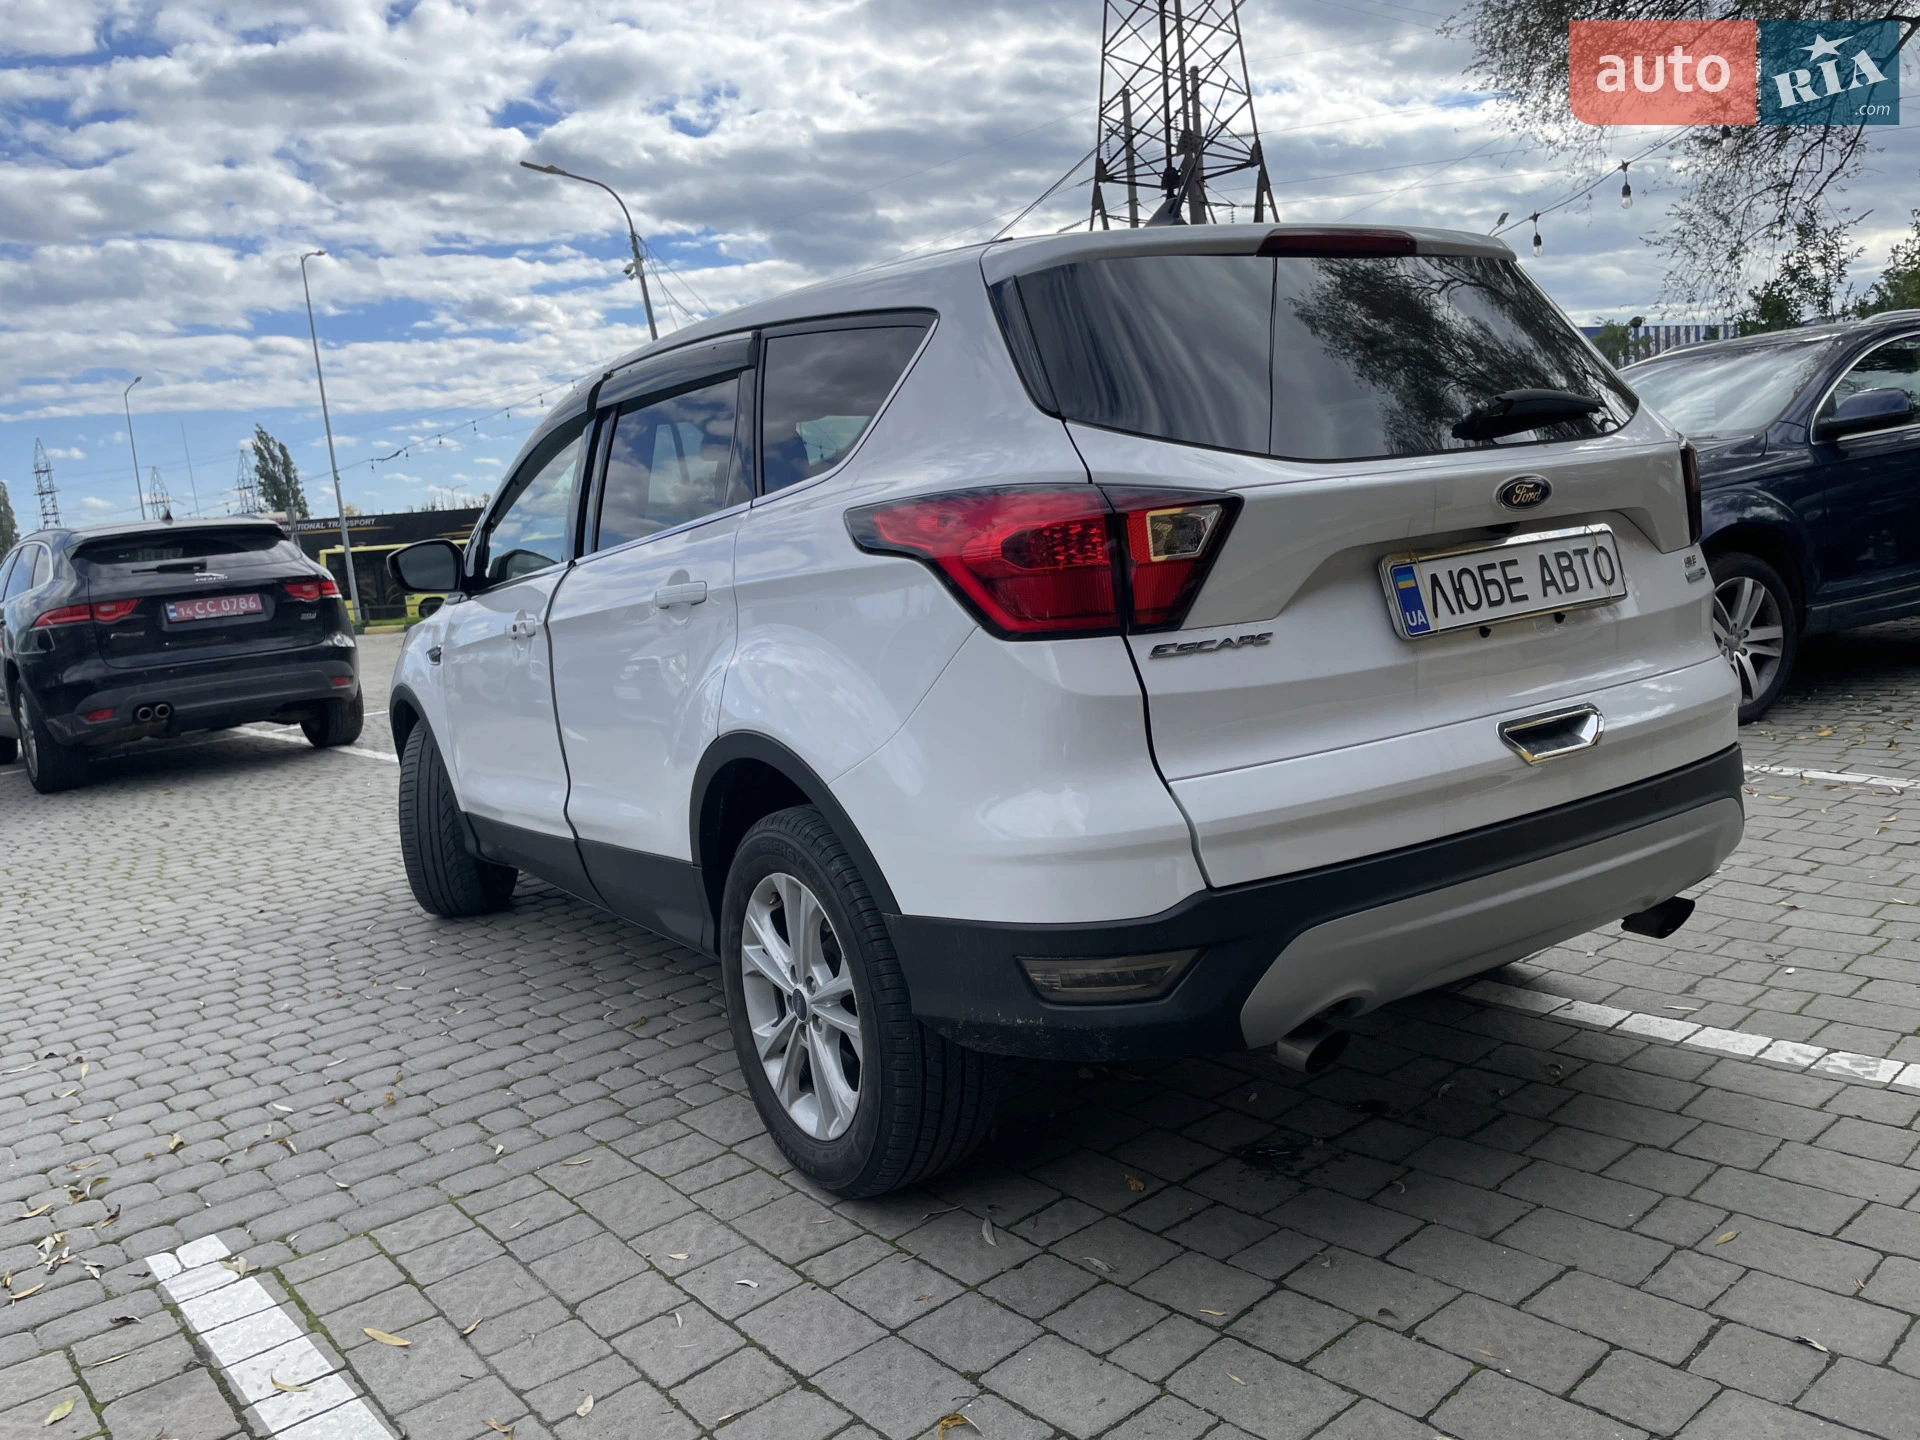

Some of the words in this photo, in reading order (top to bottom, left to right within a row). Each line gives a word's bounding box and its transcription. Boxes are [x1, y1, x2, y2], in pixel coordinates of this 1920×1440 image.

[1512, 483, 1542, 504] Ford
[1429, 558, 1529, 618] ЛЮБЕ
[1538, 545, 1616, 598] АВТО
[179, 607, 193, 616] 14
[221, 596, 256, 611] 0786
[1406, 609, 1427, 628] UA
[1148, 632, 1273, 659] ESCAPE
